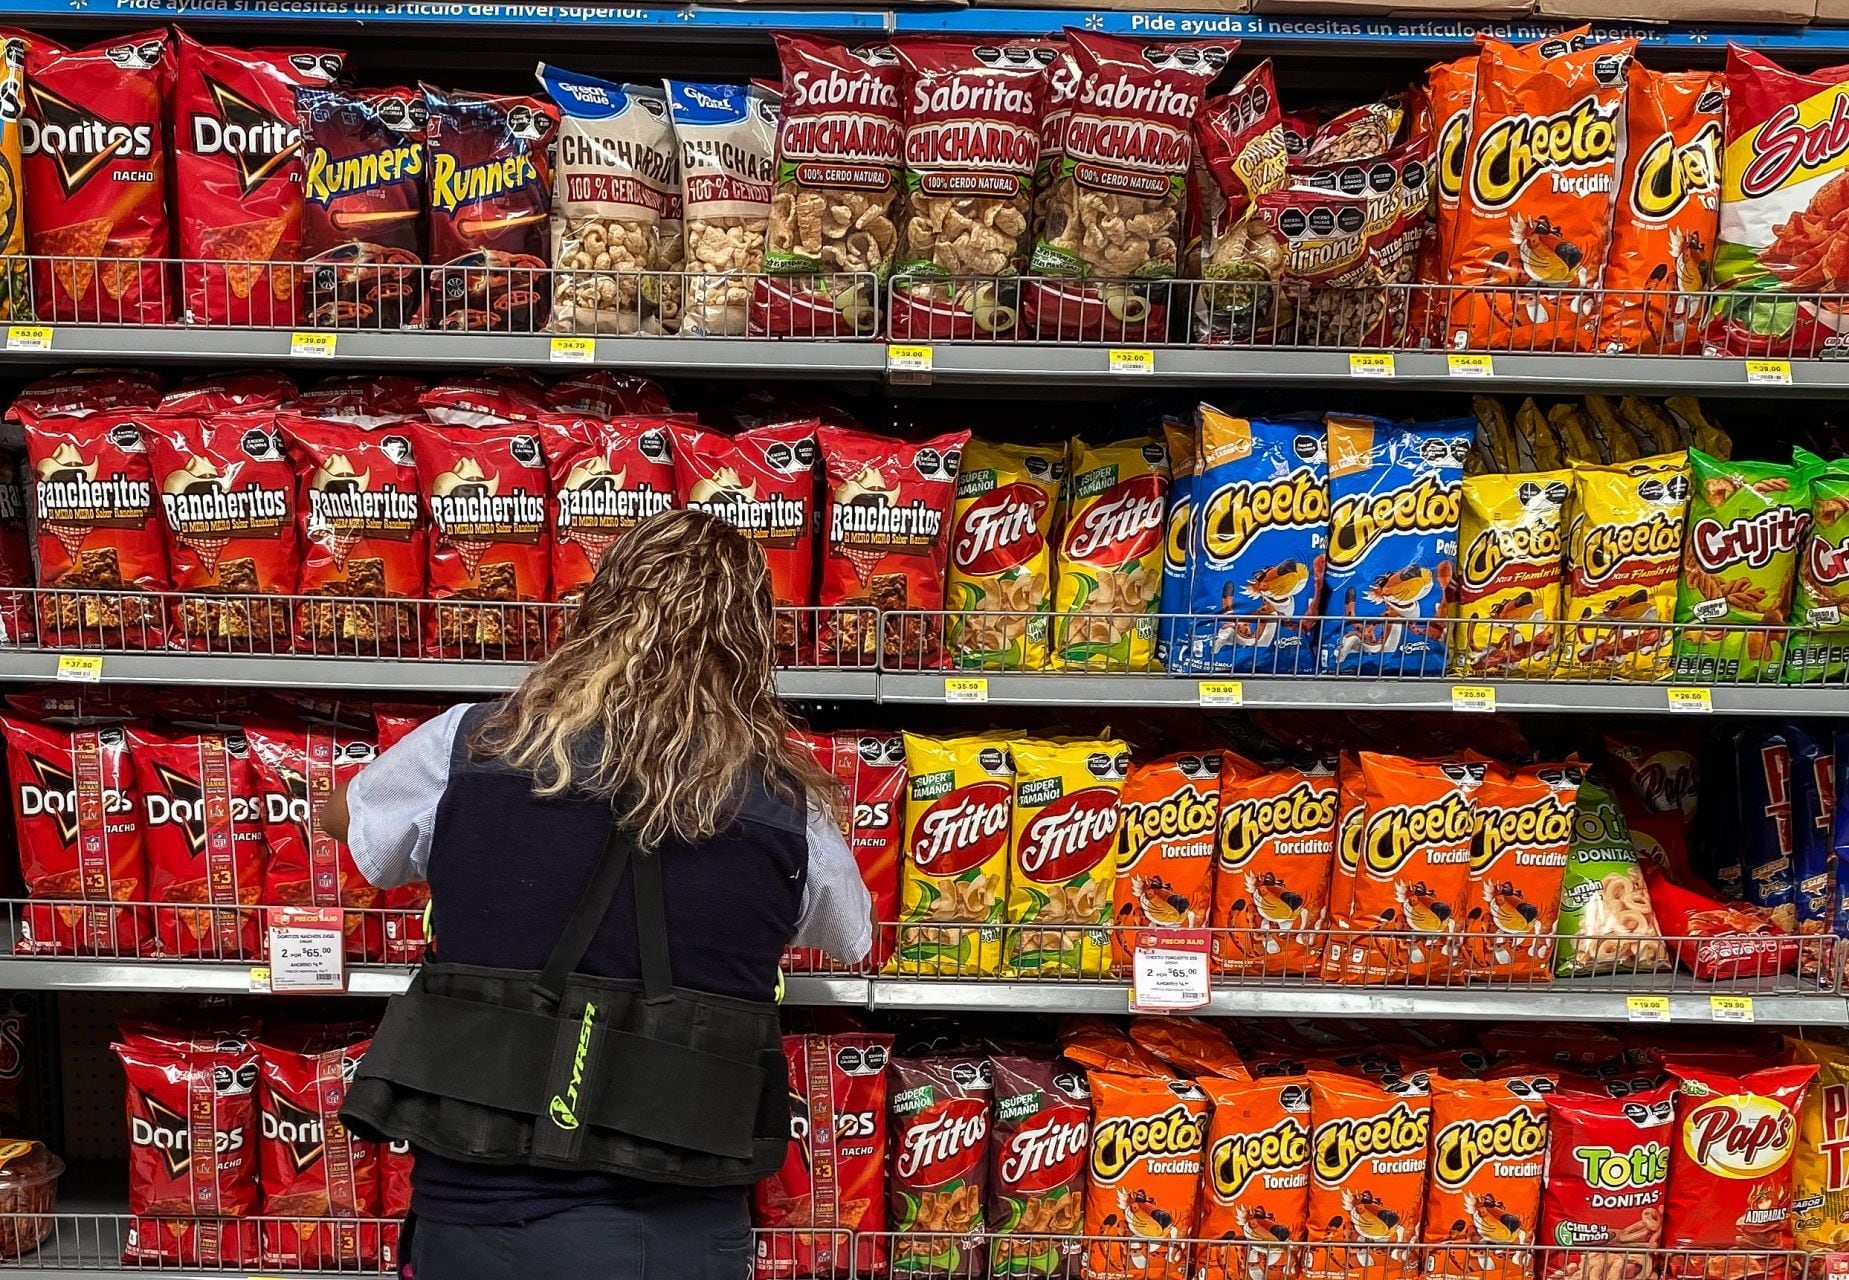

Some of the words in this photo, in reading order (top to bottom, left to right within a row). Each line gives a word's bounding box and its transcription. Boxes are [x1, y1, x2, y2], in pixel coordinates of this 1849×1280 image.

[1131, 15, 1176, 31] Pide
[1181, 17, 1242, 34] ayuda
[1248, 19, 1263, 32] si
[1269, 20, 1361, 36] necesitas
[1367, 25, 1392, 36] un
[1398, 22, 1475, 38] artículo
[1483, 25, 1512, 38] del
[1586, 27, 1661, 43] uperior.
[558, 82, 605, 97] Great
[574, 91, 610, 106] Value
[913, 77, 1033, 115] Sabritas
[1080, 73, 1199, 118] Sabritas
[20, 117, 151, 157] Doritos
[194, 116, 301, 157] Dorito
[906, 125, 1039, 171] CHICHARRÓN
[1067, 118, 1193, 168] CHICHARRÓN
[113, 170, 154, 182] NACHO
[305, 143, 423, 204] Runners
[432, 150, 537, 213] Runners
[803, 167, 824, 181] 100%
[825, 168, 853, 182] CERDO
[853, 169, 885, 184] NATURAL
[928, 176, 948, 189] 100%
[950, 176, 977, 190] CERDO
[978, 177, 1013, 191] NATURAL
[1081, 167, 1100, 184] 100%
[1101, 170, 1129, 186] CERDO
[1130, 174, 1165, 191] NATURAL
[570, 176, 591, 200] 100
[595, 177, 608, 200] %
[37, 473, 151, 519] Rancheritos
[1078, 476, 1116, 497] TAMAÑO!
[162, 483, 287, 532] Rancheritos
[308, 483, 418, 530] Rancheritos
[431, 487, 545, 534] Rancheritos
[557, 482, 672, 527] Rancheritos
[830, 497, 942, 543] Rancheritos
[1070, 491, 1166, 558] Frito
[1328, 475, 1462, 563] Cheetos
[1469, 518, 1561, 583] Cheetos
[1584, 511, 1682, 577] Cheetos
[914, 782, 953, 798] TAMAÑO!
[1020, 788, 1060, 805] TAMAÑO!
[1022, 780, 1055, 795] ¡SÚPER
[105, 823, 136, 835] NACHO
[232, 832, 262, 841] NACHO
[1021, 795, 1121, 873] Fritos
[1221, 787, 1336, 862] Cheetos
[853, 838, 887, 847] NACHO
[1161, 843, 1214, 859] Torcidito
[1274, 840, 1334, 855] Torciditos
[1579, 849, 1637, 864] DONITAS
[1515, 850, 1568, 867] Torcidito
[281, 949, 288, 958] 2
[1147, 968, 1153, 977] 2
[999, 1103, 1040, 1120] TAMAÑO!
[897, 1106, 989, 1178] Fritos
[1094, 1107, 1206, 1178] Cheetos
[1316, 1102, 1430, 1180] Cheetos
[1692, 1106, 1793, 1165] Pap's
[841, 1146, 874, 1156] NACHO
[1577, 1143, 1669, 1187] Totis
[1147, 1159, 1200, 1174] Torcidito
[1372, 1158, 1426, 1174] Torciditos
[1592, 1193, 1659, 1208] DONITAS
